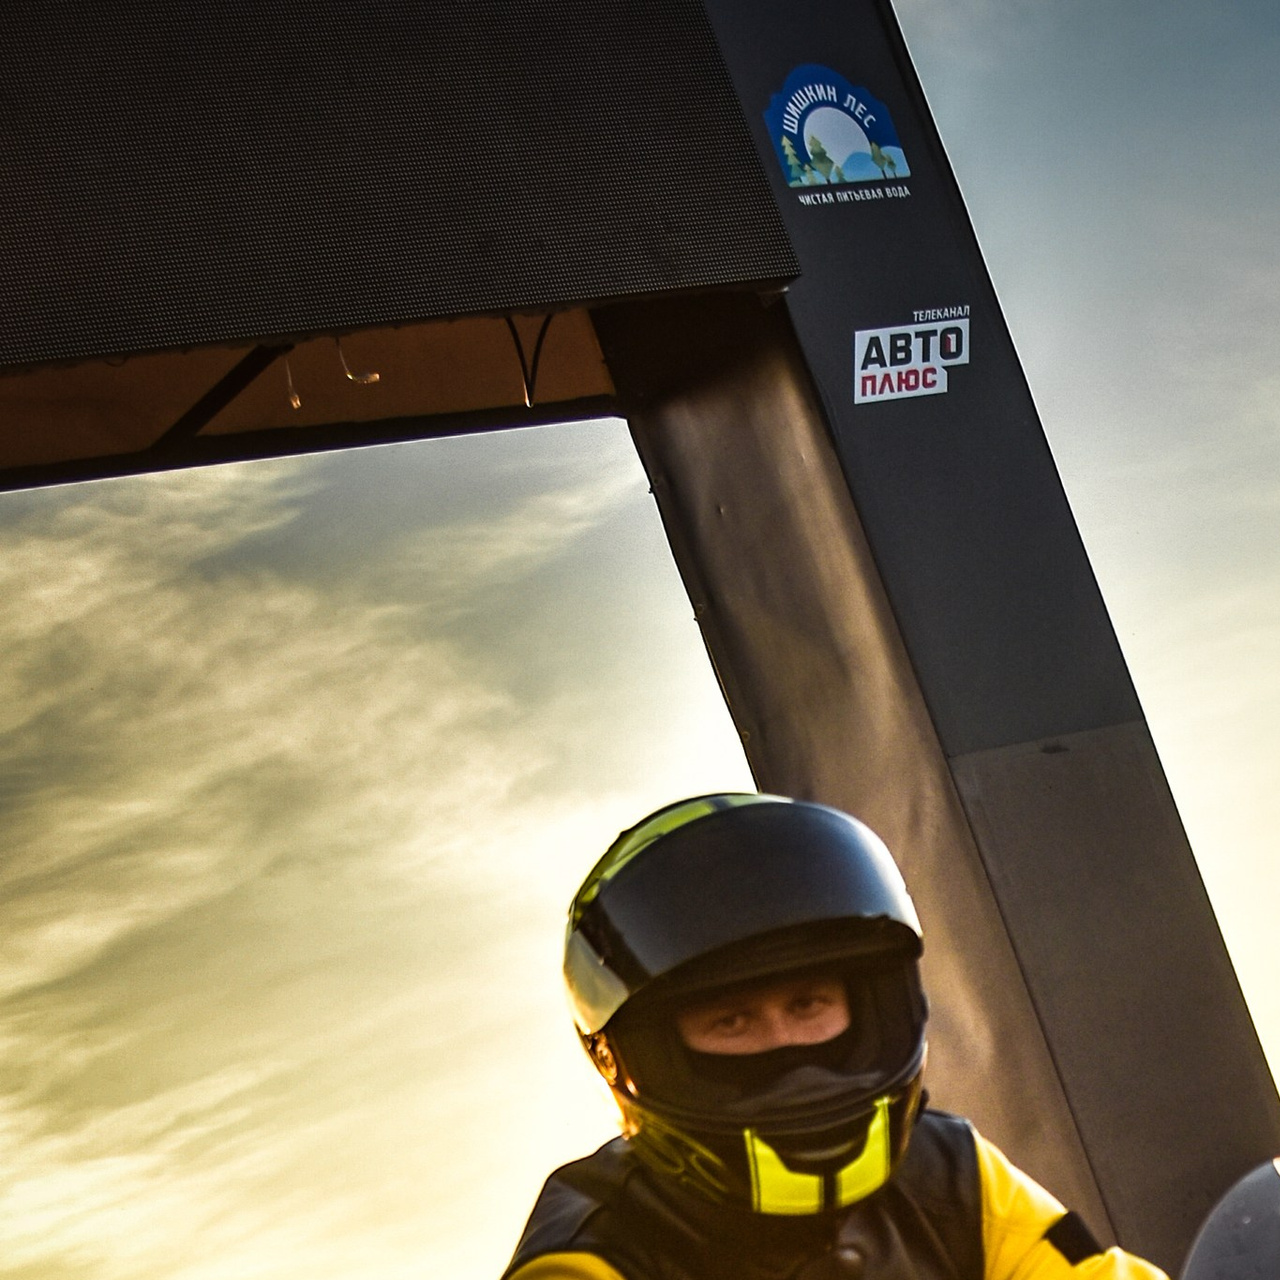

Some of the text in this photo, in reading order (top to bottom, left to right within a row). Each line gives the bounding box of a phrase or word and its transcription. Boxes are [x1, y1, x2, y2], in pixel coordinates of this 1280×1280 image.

[782, 83, 877, 135] ШИШКИН ЛЕС
[798, 185, 911, 206] ЧИСТАЯ ПИТЬЕВАЯ ВОДА
[913, 305, 970, 322] ТЕЛЕКАНАЛ
[861, 326, 963, 371] АВТО
[861, 367, 937, 397] ПЛЮС
